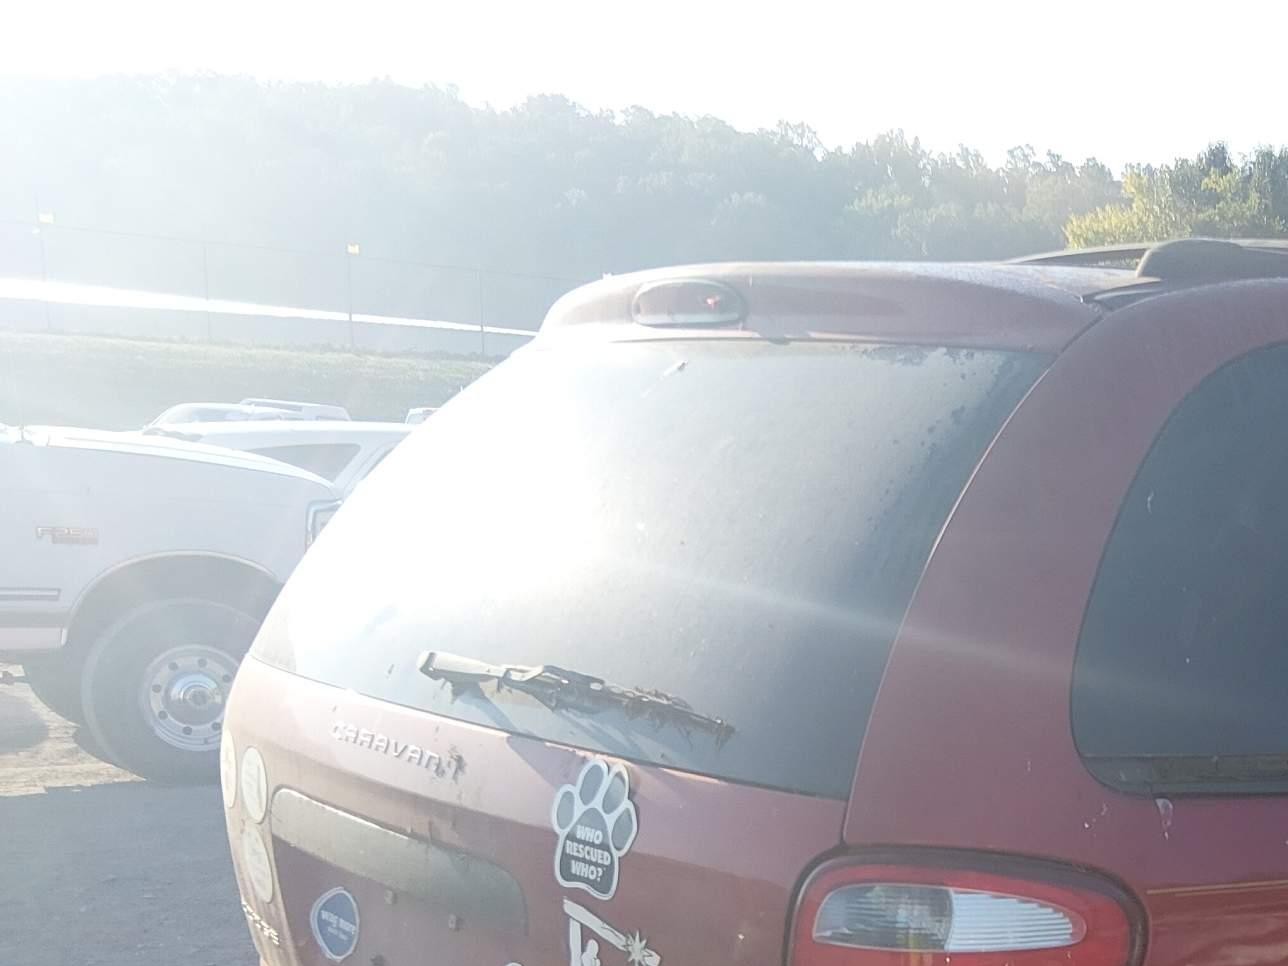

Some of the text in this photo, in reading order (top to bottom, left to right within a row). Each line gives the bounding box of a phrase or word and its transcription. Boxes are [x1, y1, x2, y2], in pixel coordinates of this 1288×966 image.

[576, 824, 603, 845] WHO
[565, 839, 612, 866] RESCUED
[571, 859, 603, 882] WHO?
